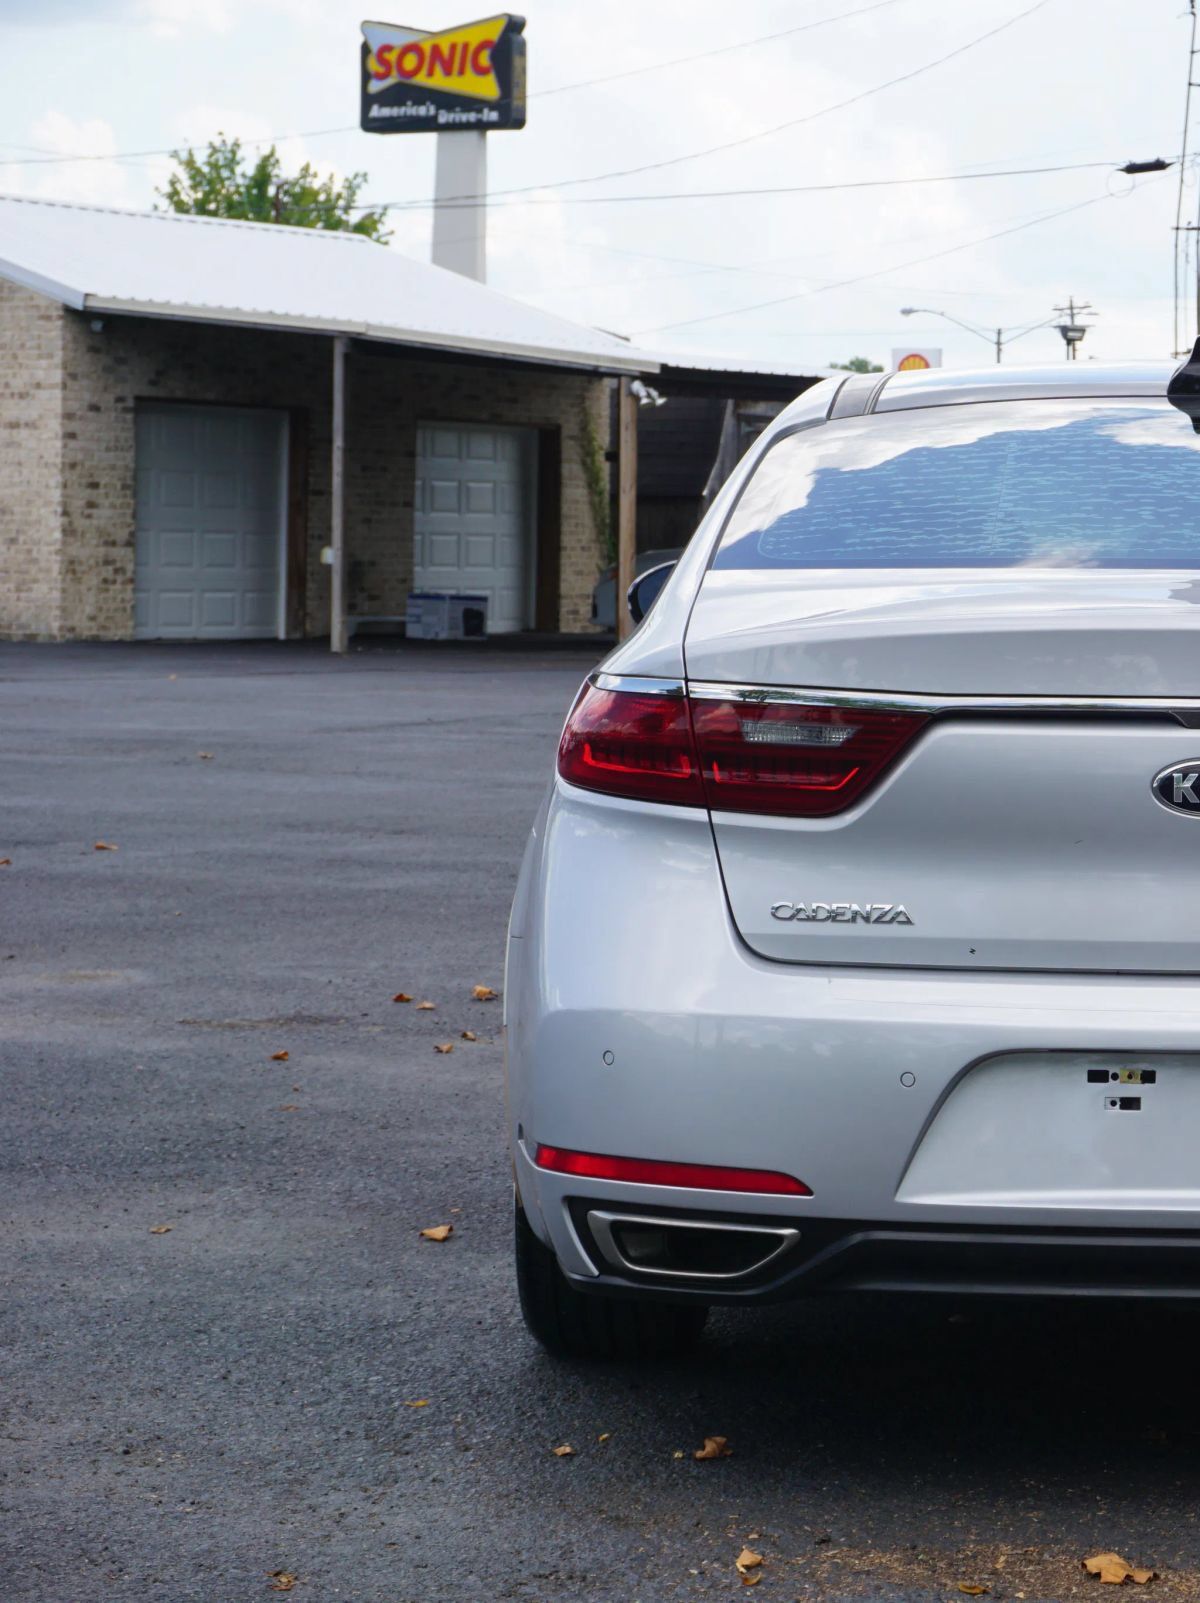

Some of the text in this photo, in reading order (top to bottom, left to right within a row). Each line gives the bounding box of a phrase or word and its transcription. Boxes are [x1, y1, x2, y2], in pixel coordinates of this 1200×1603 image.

[372, 39, 496, 81] SONIC
[368, 100, 499, 124] America's Drive-In
[770, 901, 915, 926] CADENZA
